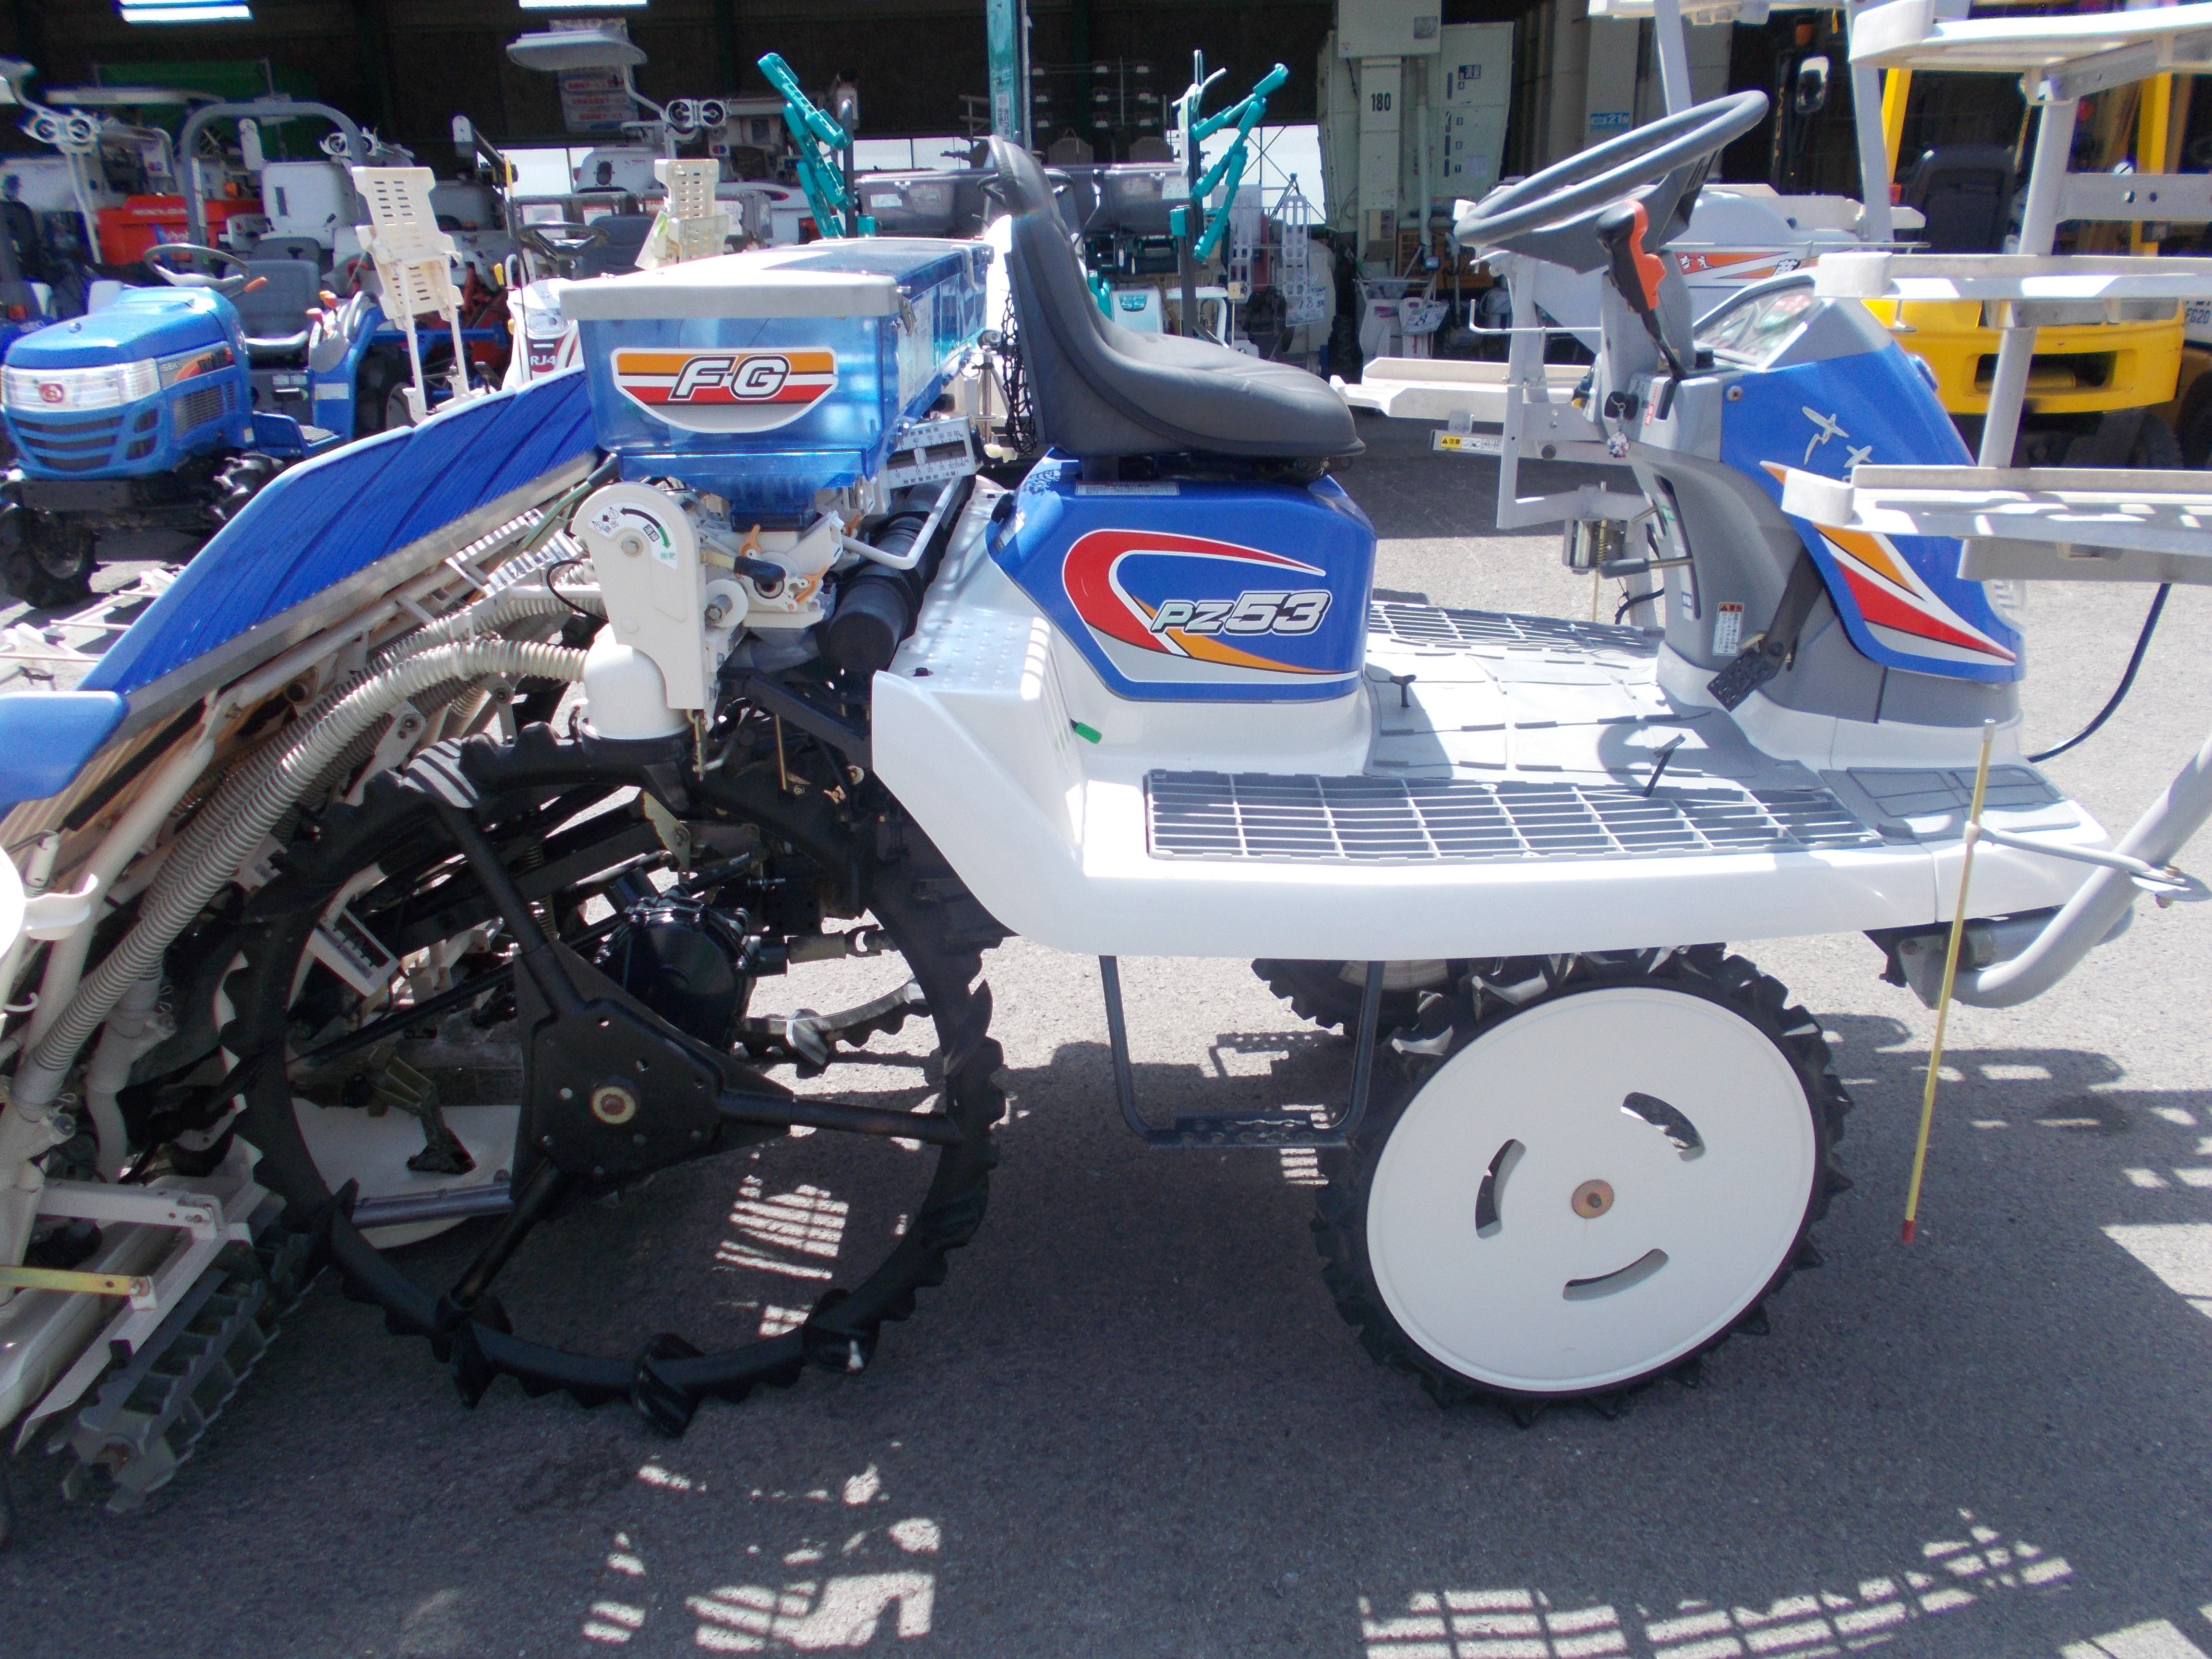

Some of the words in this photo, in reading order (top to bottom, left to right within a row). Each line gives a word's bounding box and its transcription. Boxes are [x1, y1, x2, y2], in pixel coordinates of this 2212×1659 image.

[1371, 92, 1391, 111] 180
[668, 355, 791, 400] FG
[1150, 590, 1332, 635] PZ53
